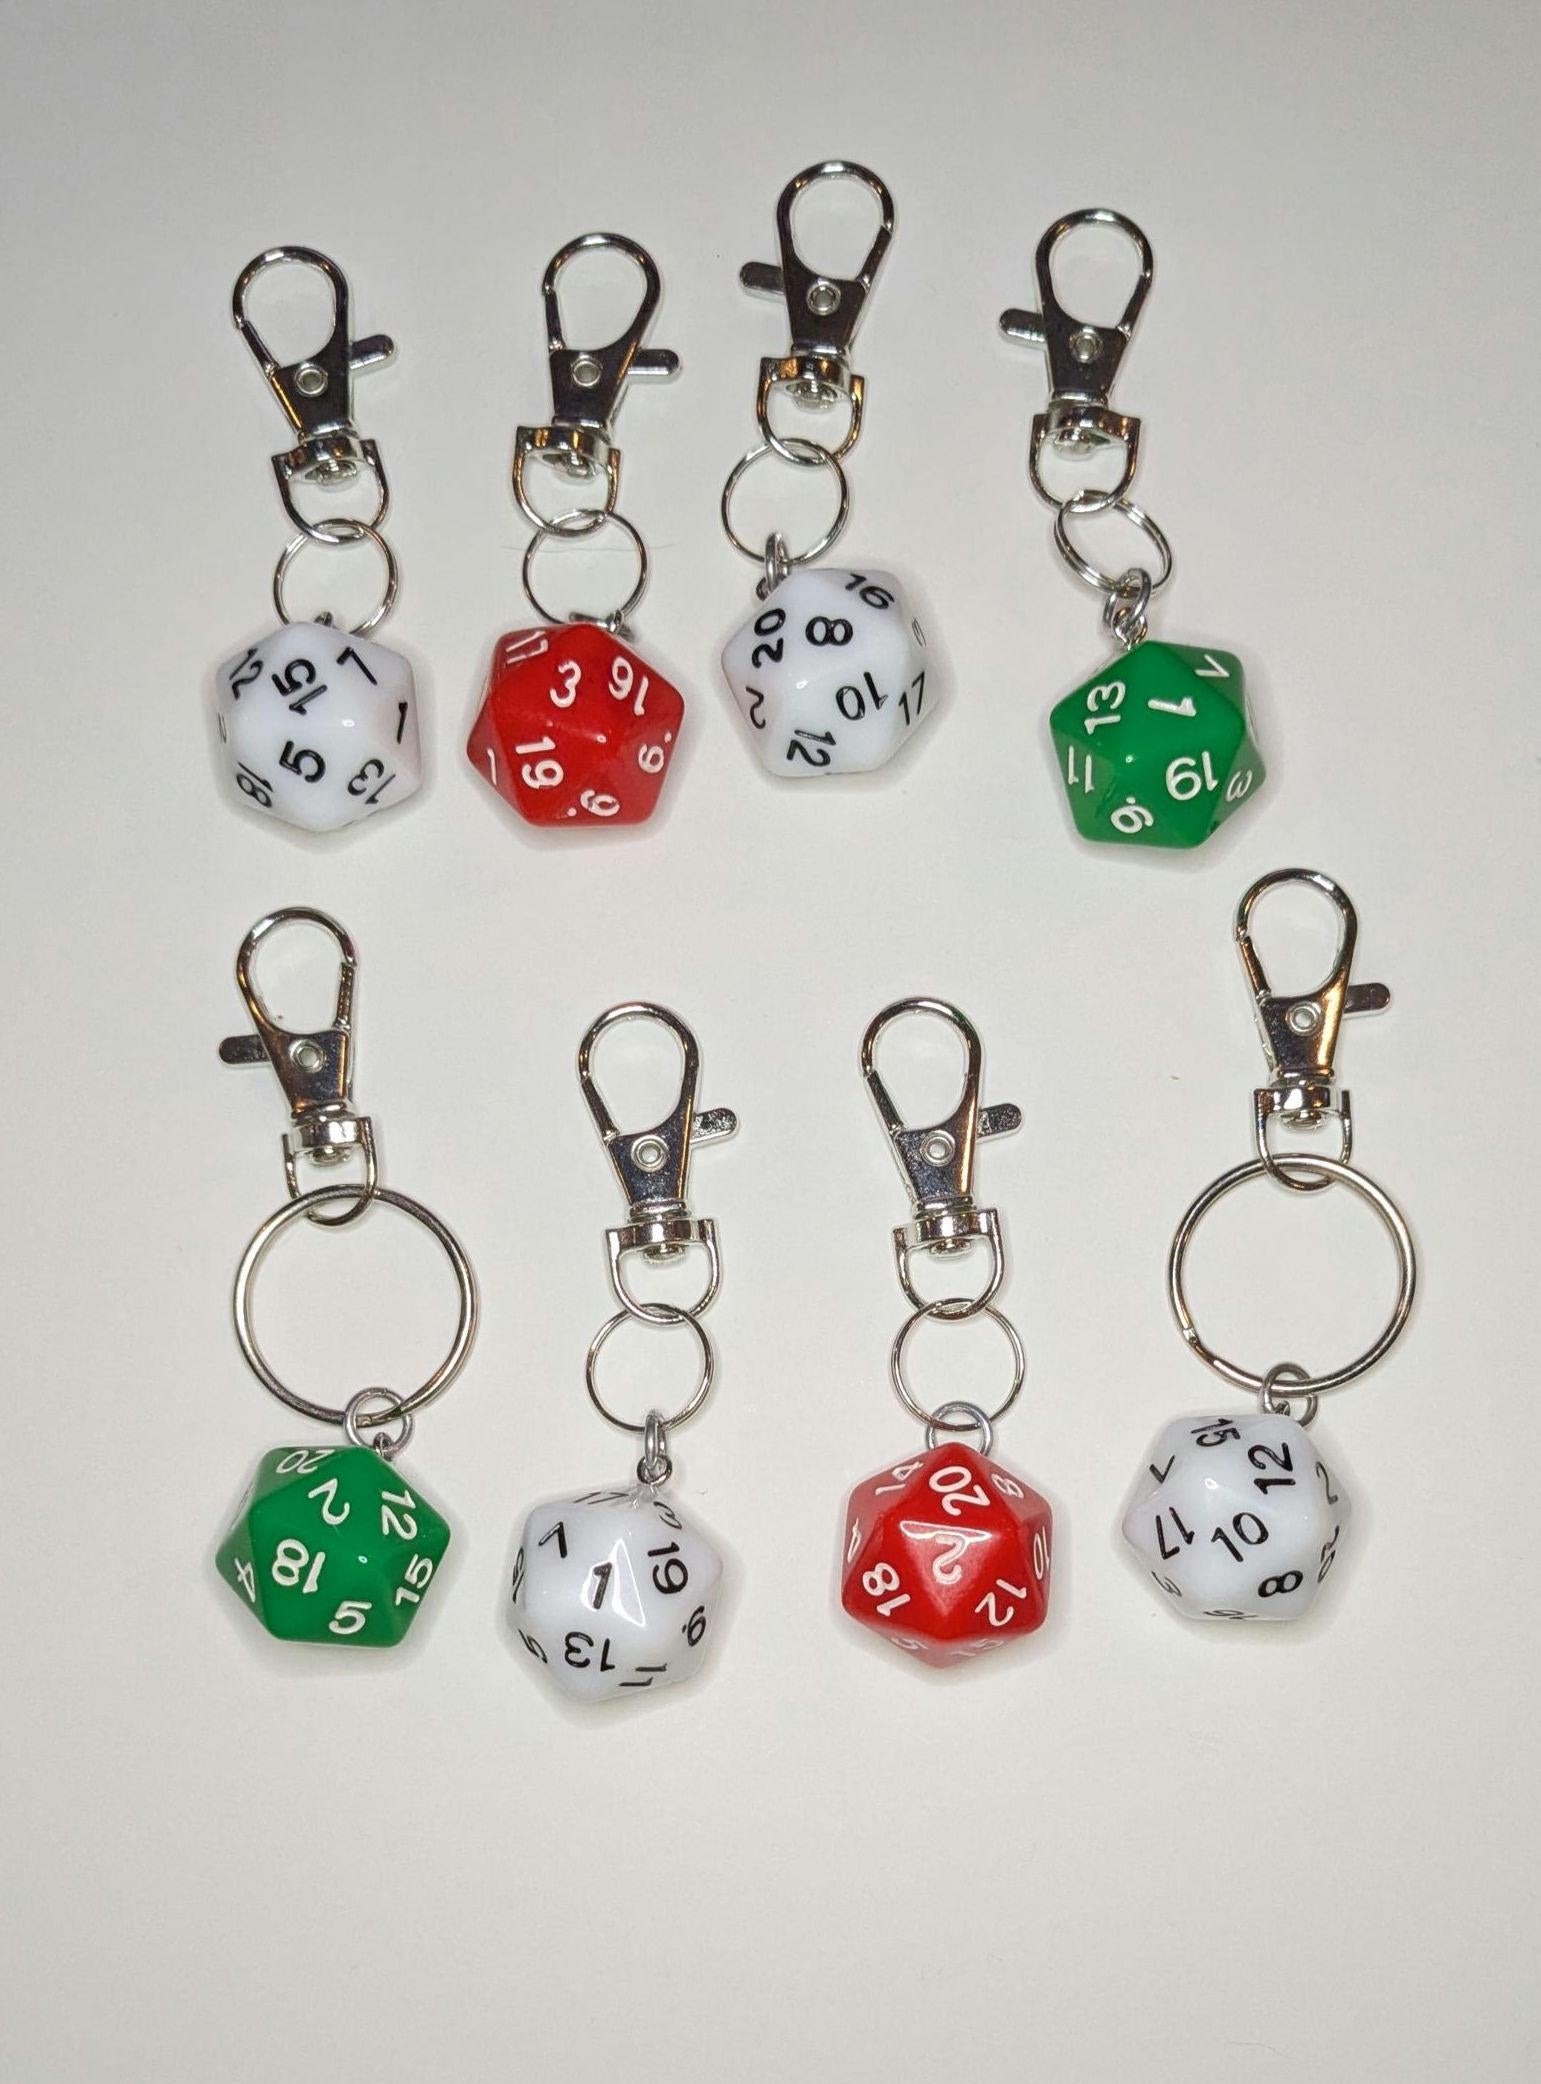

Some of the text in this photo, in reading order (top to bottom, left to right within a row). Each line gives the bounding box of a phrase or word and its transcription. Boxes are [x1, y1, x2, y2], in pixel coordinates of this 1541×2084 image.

[845, 573, 895, 610] 16
[752, 608, 786, 669] 20
[805, 616, 853, 647] 8
[229, 648, 263, 700] 12
[272, 658, 327, 716] 15
[337, 647, 378, 686] 7
[550, 660, 581, 708] 3
[609, 657, 649, 716] 16
[745, 687, 766, 730] 2
[835, 671, 889, 721] 10
[898, 671, 925, 726] 17
[1084, 681, 1126, 735] 13
[1148, 696, 1197, 717] 1
[397, 702, 408, 744] 1
[279, 740, 325, 783] 5
[515, 736, 564, 790] 19
[786, 729, 836, 767] 12
[1068, 746, 1094, 794] 11
[237, 762, 274, 808] 18
[347, 759, 396, 805] 13
[1166, 751, 1218, 801] 19
[1226, 770, 1252, 802] 3
[1190, 1418, 1241, 1447] 15
[276, 1449, 335, 1474] 20
[990, 1473, 1024, 1498] 8
[1247, 1442, 1296, 1495] 12
[1316, 1461, 1338, 1506] 2
[308, 1478, 350, 1525] 2
[929, 1466, 990, 1516] 20
[381, 1490, 417, 1541] 12
[1155, 1506, 1195, 1560] 17
[1211, 1512, 1269, 1562] 10
[538, 1521, 568, 1559] 7
[932, 1532, 966, 1585] 2
[234, 1557, 256, 1603] 4
[272, 1538, 326, 1594] 18
[395, 1554, 433, 1606] 15
[593, 1561, 613, 1610] 1
[647, 1541, 688, 1594] 19
[862, 1562, 911, 1617] 18
[1257, 1570, 1303, 1598] 8
[328, 1600, 373, 1635] 5
[975, 1578, 1027, 1627] 12
[564, 1631, 615, 1672] 13
